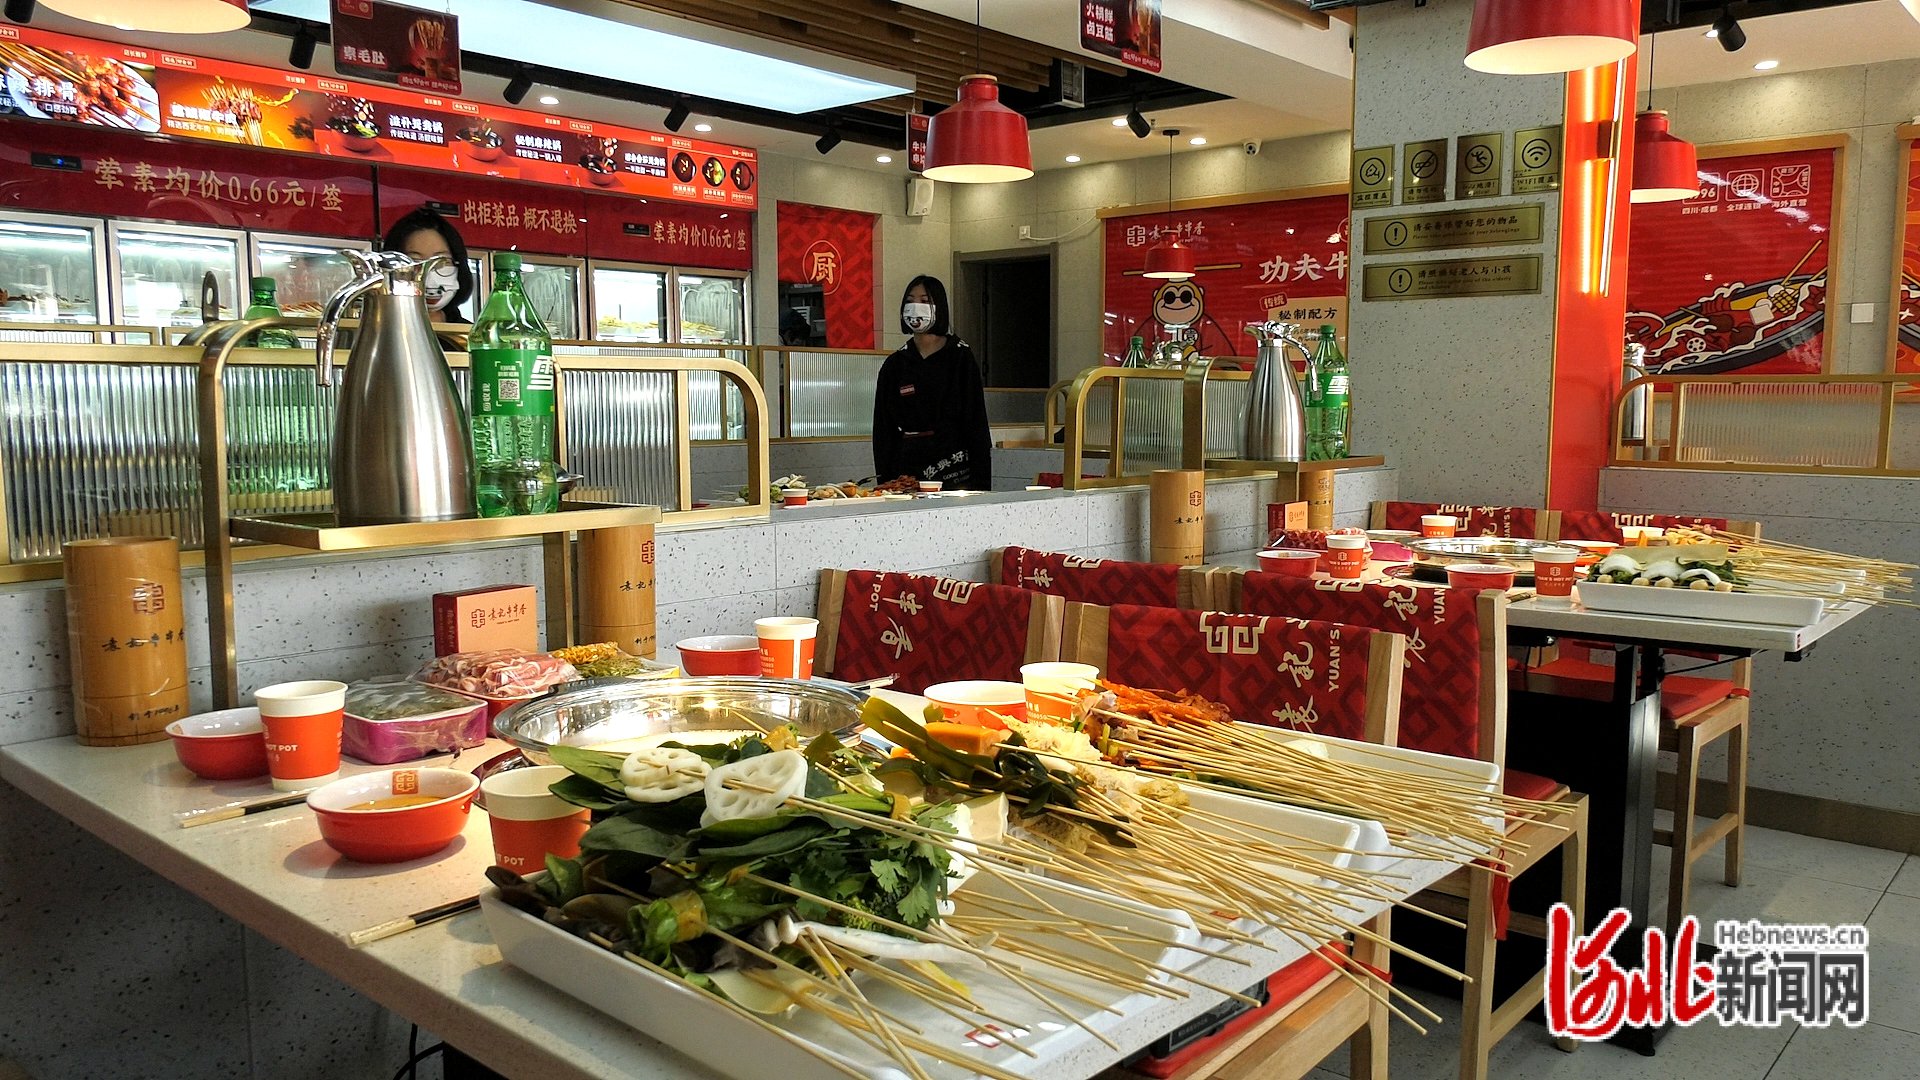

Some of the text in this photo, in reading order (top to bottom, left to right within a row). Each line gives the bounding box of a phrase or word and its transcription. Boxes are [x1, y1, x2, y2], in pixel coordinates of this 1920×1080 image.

[94, 157, 343, 212] 荤素均价0.66元/签
[464, 199, 577, 234] 出柜菜品 概不退换
[653, 219, 746, 250] 荤素均价0.66元/签
[810, 251, 836, 284] 厨
[1279, 307, 1337, 321] 秘制配方
[869, 583, 882, 612] POT
[1328, 628, 1341, 693] YUAN'S
[278, 744, 298, 752] POT
[503, 855, 525, 866] POT
